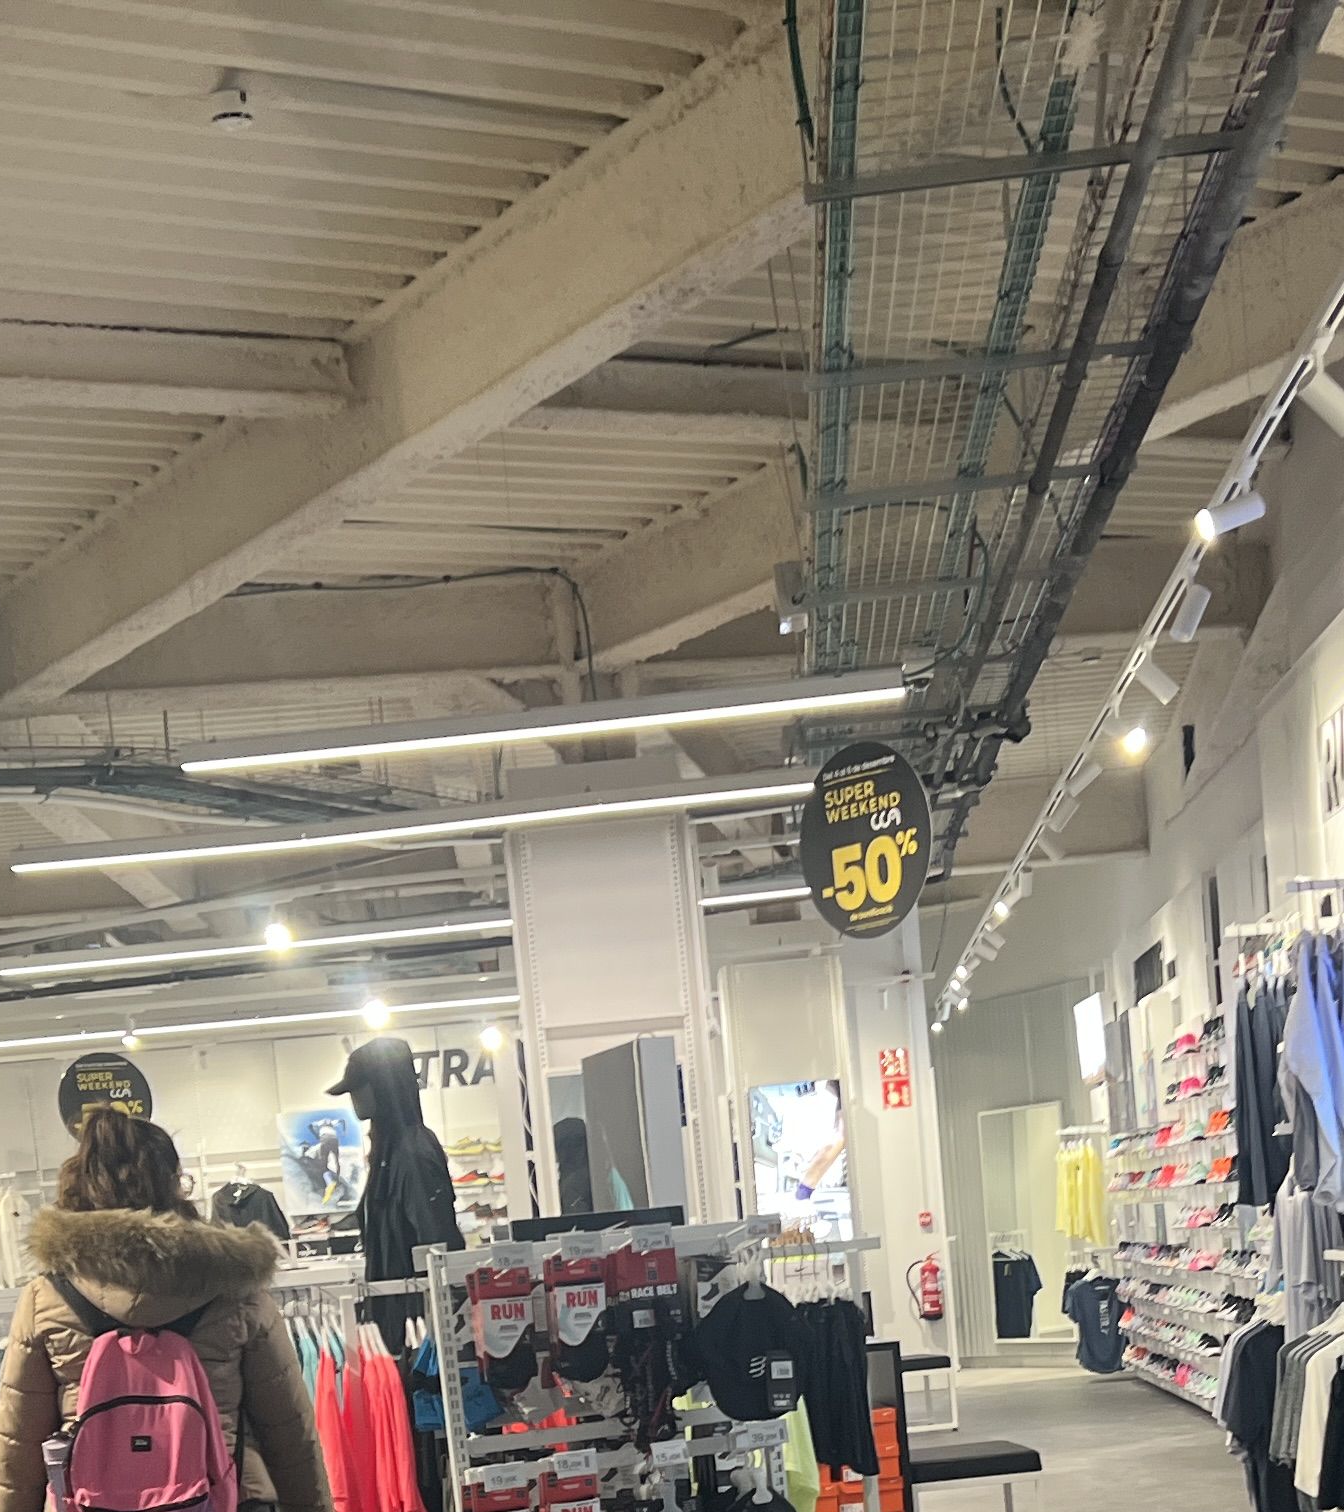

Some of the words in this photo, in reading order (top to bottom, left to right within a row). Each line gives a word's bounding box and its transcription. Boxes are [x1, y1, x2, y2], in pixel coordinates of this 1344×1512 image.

[824, 780, 875, 809] SUPER
[825, 791, 902, 825] WEEKEND
[822, 827, 919, 911] -50%
[76, 1071, 113, 1083] SUPER
[77, 1080, 132, 1091] WEEKEND
[566, 1289, 598, 1309] RUN
[490, 1302, 525, 1320] RUN
